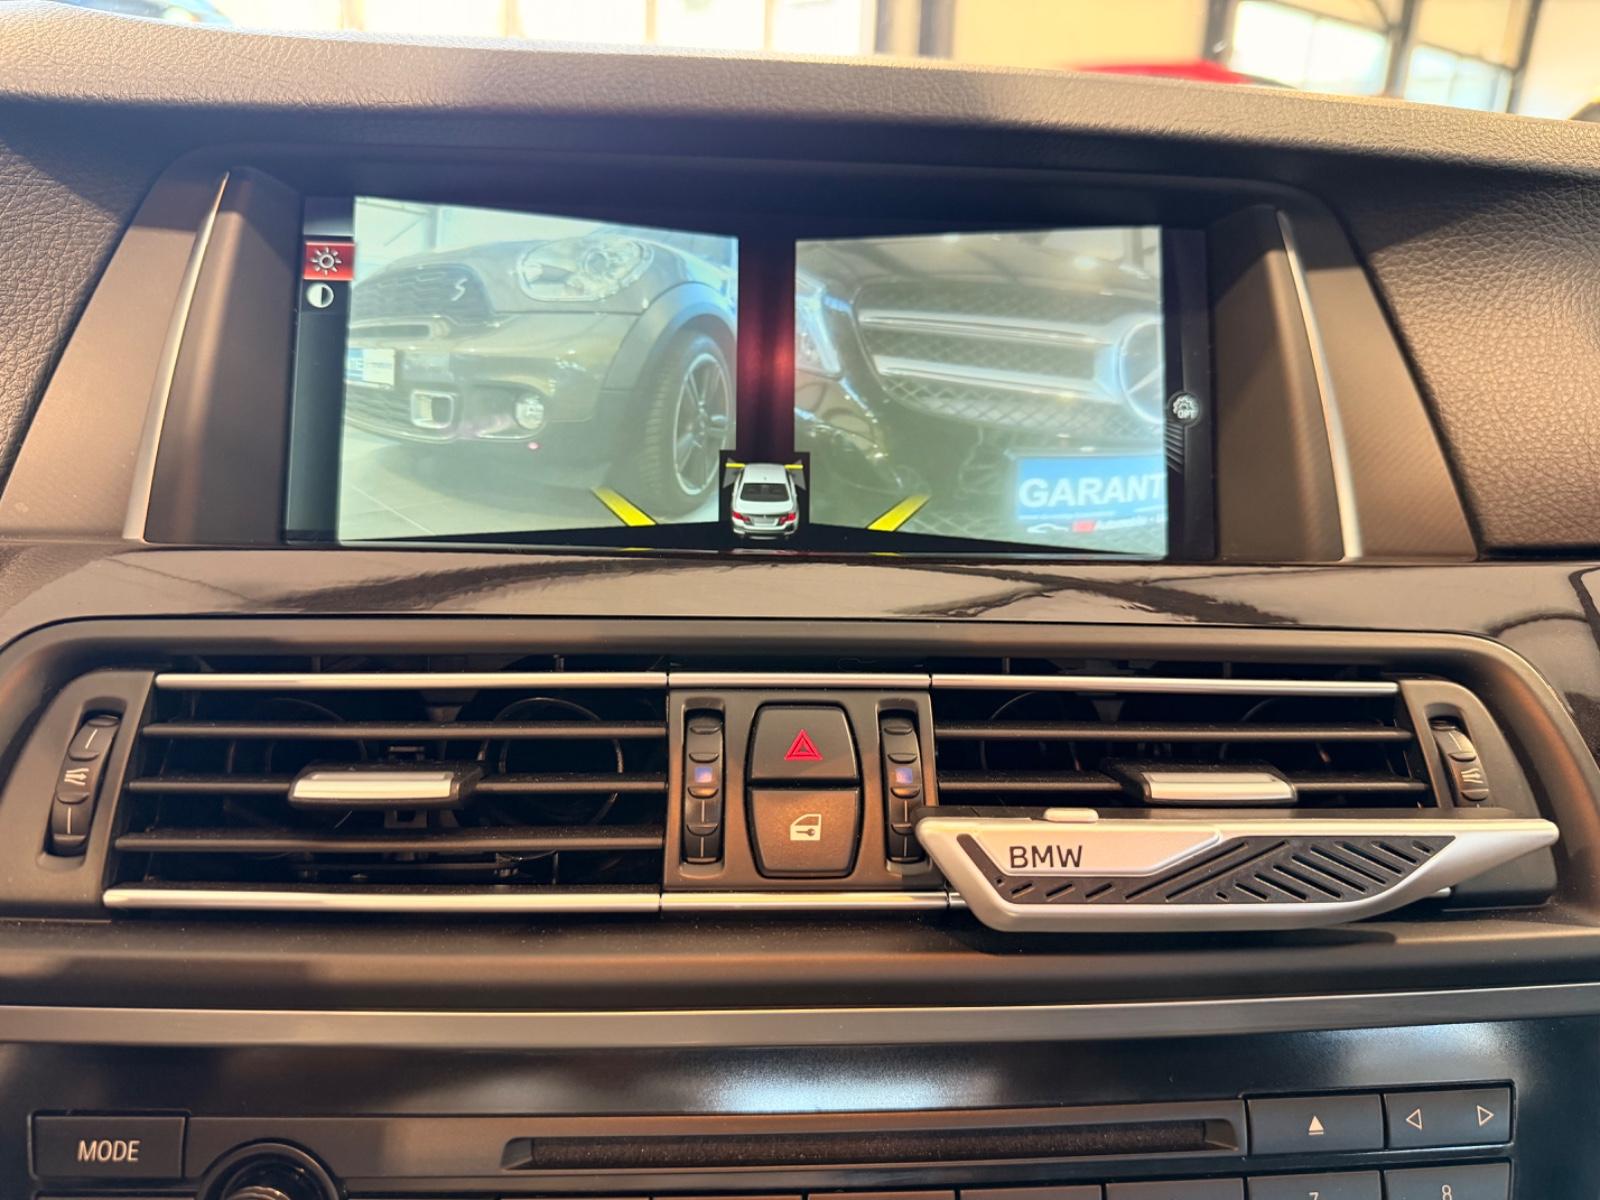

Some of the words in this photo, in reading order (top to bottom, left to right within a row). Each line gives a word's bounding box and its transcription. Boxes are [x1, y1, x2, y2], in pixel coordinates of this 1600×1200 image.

[1018, 474, 1167, 507] GARANT
[1009, 845, 1083, 869] BMW
[77, 1140, 140, 1162] MODE
[1441, 1184, 1453, 1200] 8
